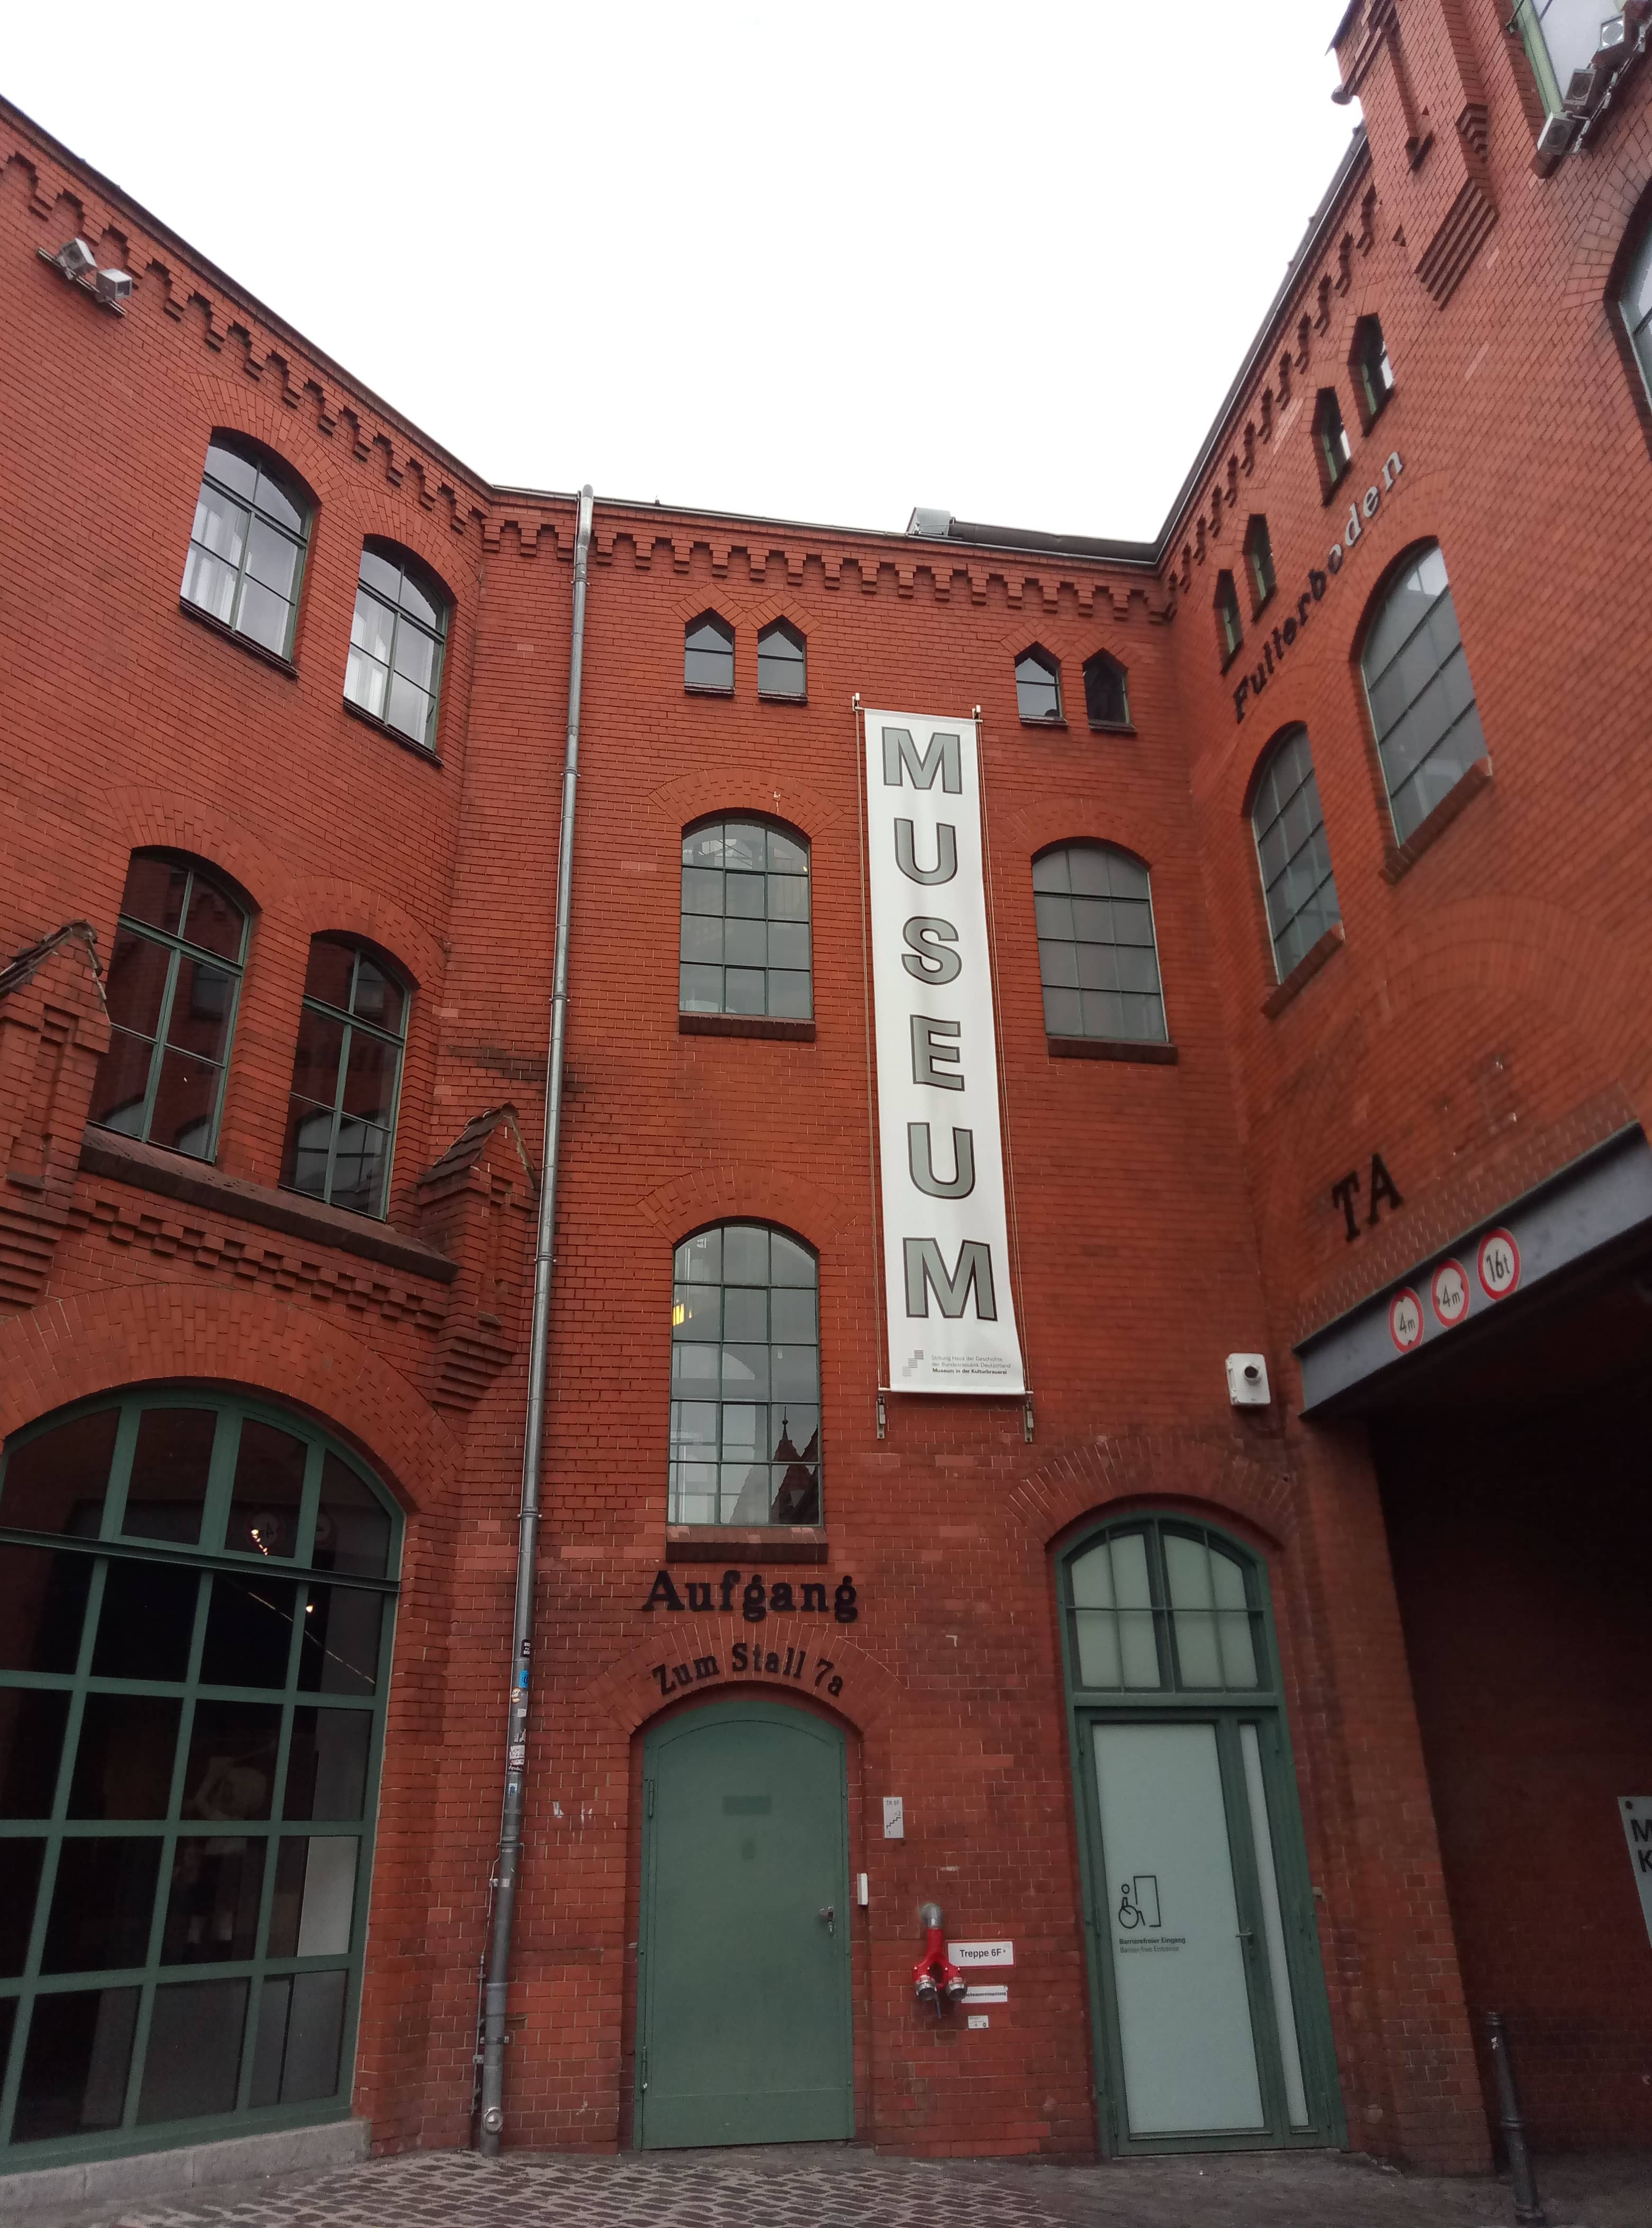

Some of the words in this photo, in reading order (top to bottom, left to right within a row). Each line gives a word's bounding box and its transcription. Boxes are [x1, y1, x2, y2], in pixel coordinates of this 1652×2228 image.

[881, 726, 998, 1322] MUSEUM
[1486, 1249, 1511, 1282] 16t
[1442, 1285, 1460, 1308] 4m
[1399, 1313, 1415, 1334] 4m
[642, 1570, 858, 1623] Aufgang
[652, 1654, 720, 1696] Zum
[732, 1642, 806, 1678] Stall
[814, 1658, 843, 1696] 7a
[959, 1949, 989, 1959] Treppe
